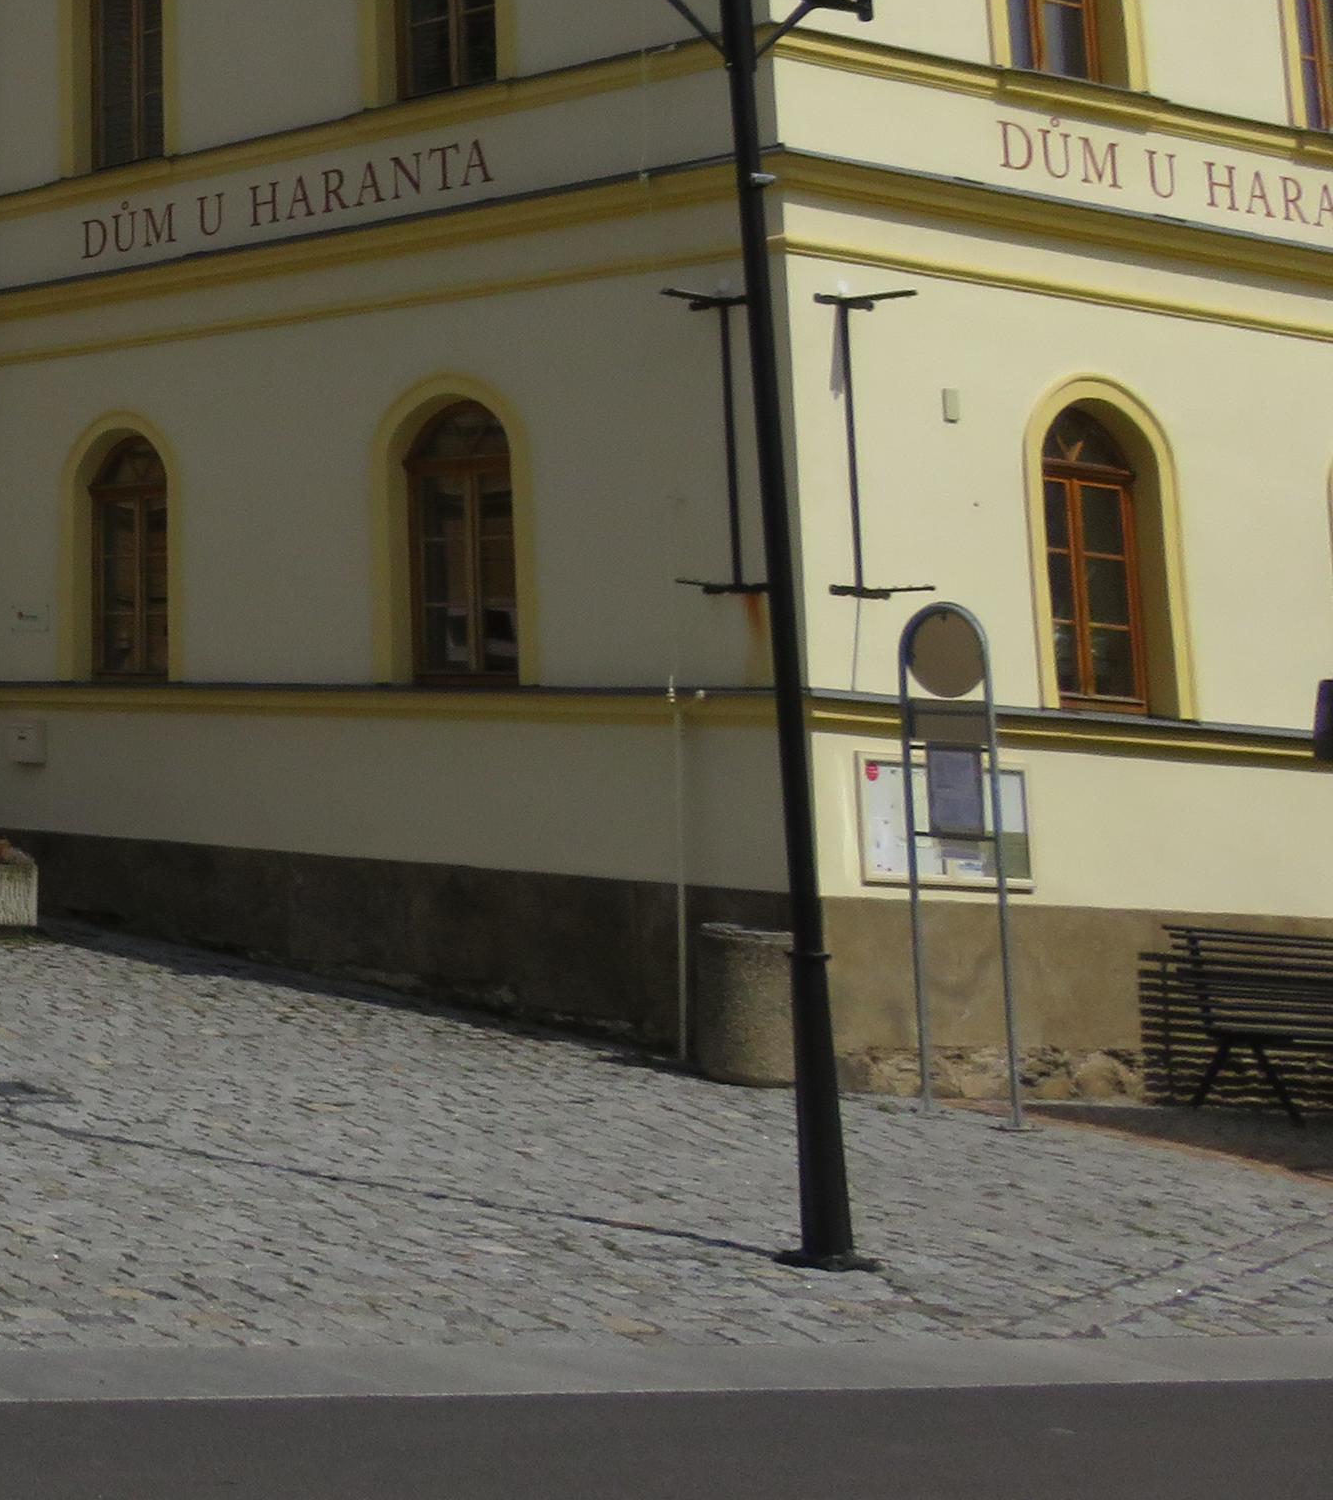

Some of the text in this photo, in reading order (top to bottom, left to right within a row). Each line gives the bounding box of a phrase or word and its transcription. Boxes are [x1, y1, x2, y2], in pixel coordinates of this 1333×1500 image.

[81, 138, 495, 259] DŮM U HARANTA
[996, 115, 1123, 190] DŮM
[1144, 149, 1176, 198] U
